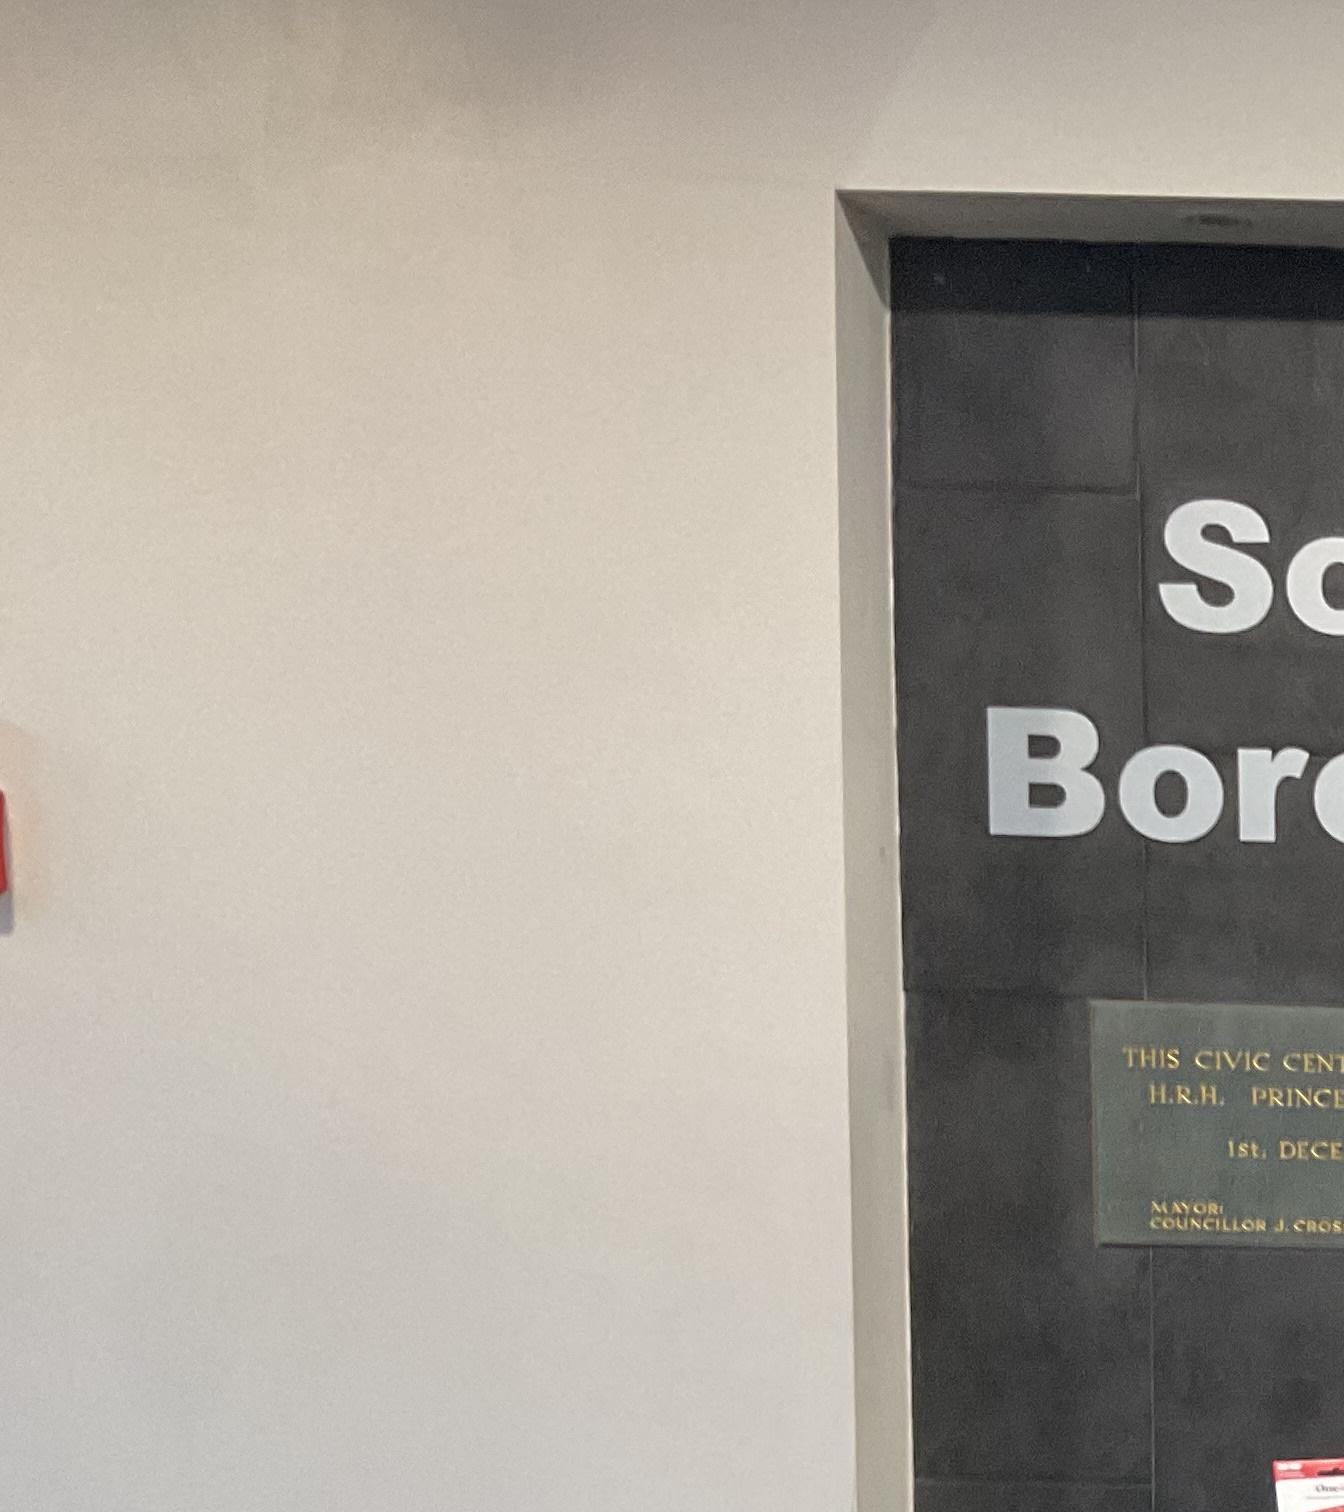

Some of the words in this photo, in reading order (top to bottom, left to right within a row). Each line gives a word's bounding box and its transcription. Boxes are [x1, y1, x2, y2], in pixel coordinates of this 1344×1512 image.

[1122, 1046, 1180, 1071] THIS
[1194, 1048, 1271, 1073] CIVIC
[1149, 1084, 1226, 1107] H.R.H.
[1149, 1215, 1267, 1233] COUNCILLOR
